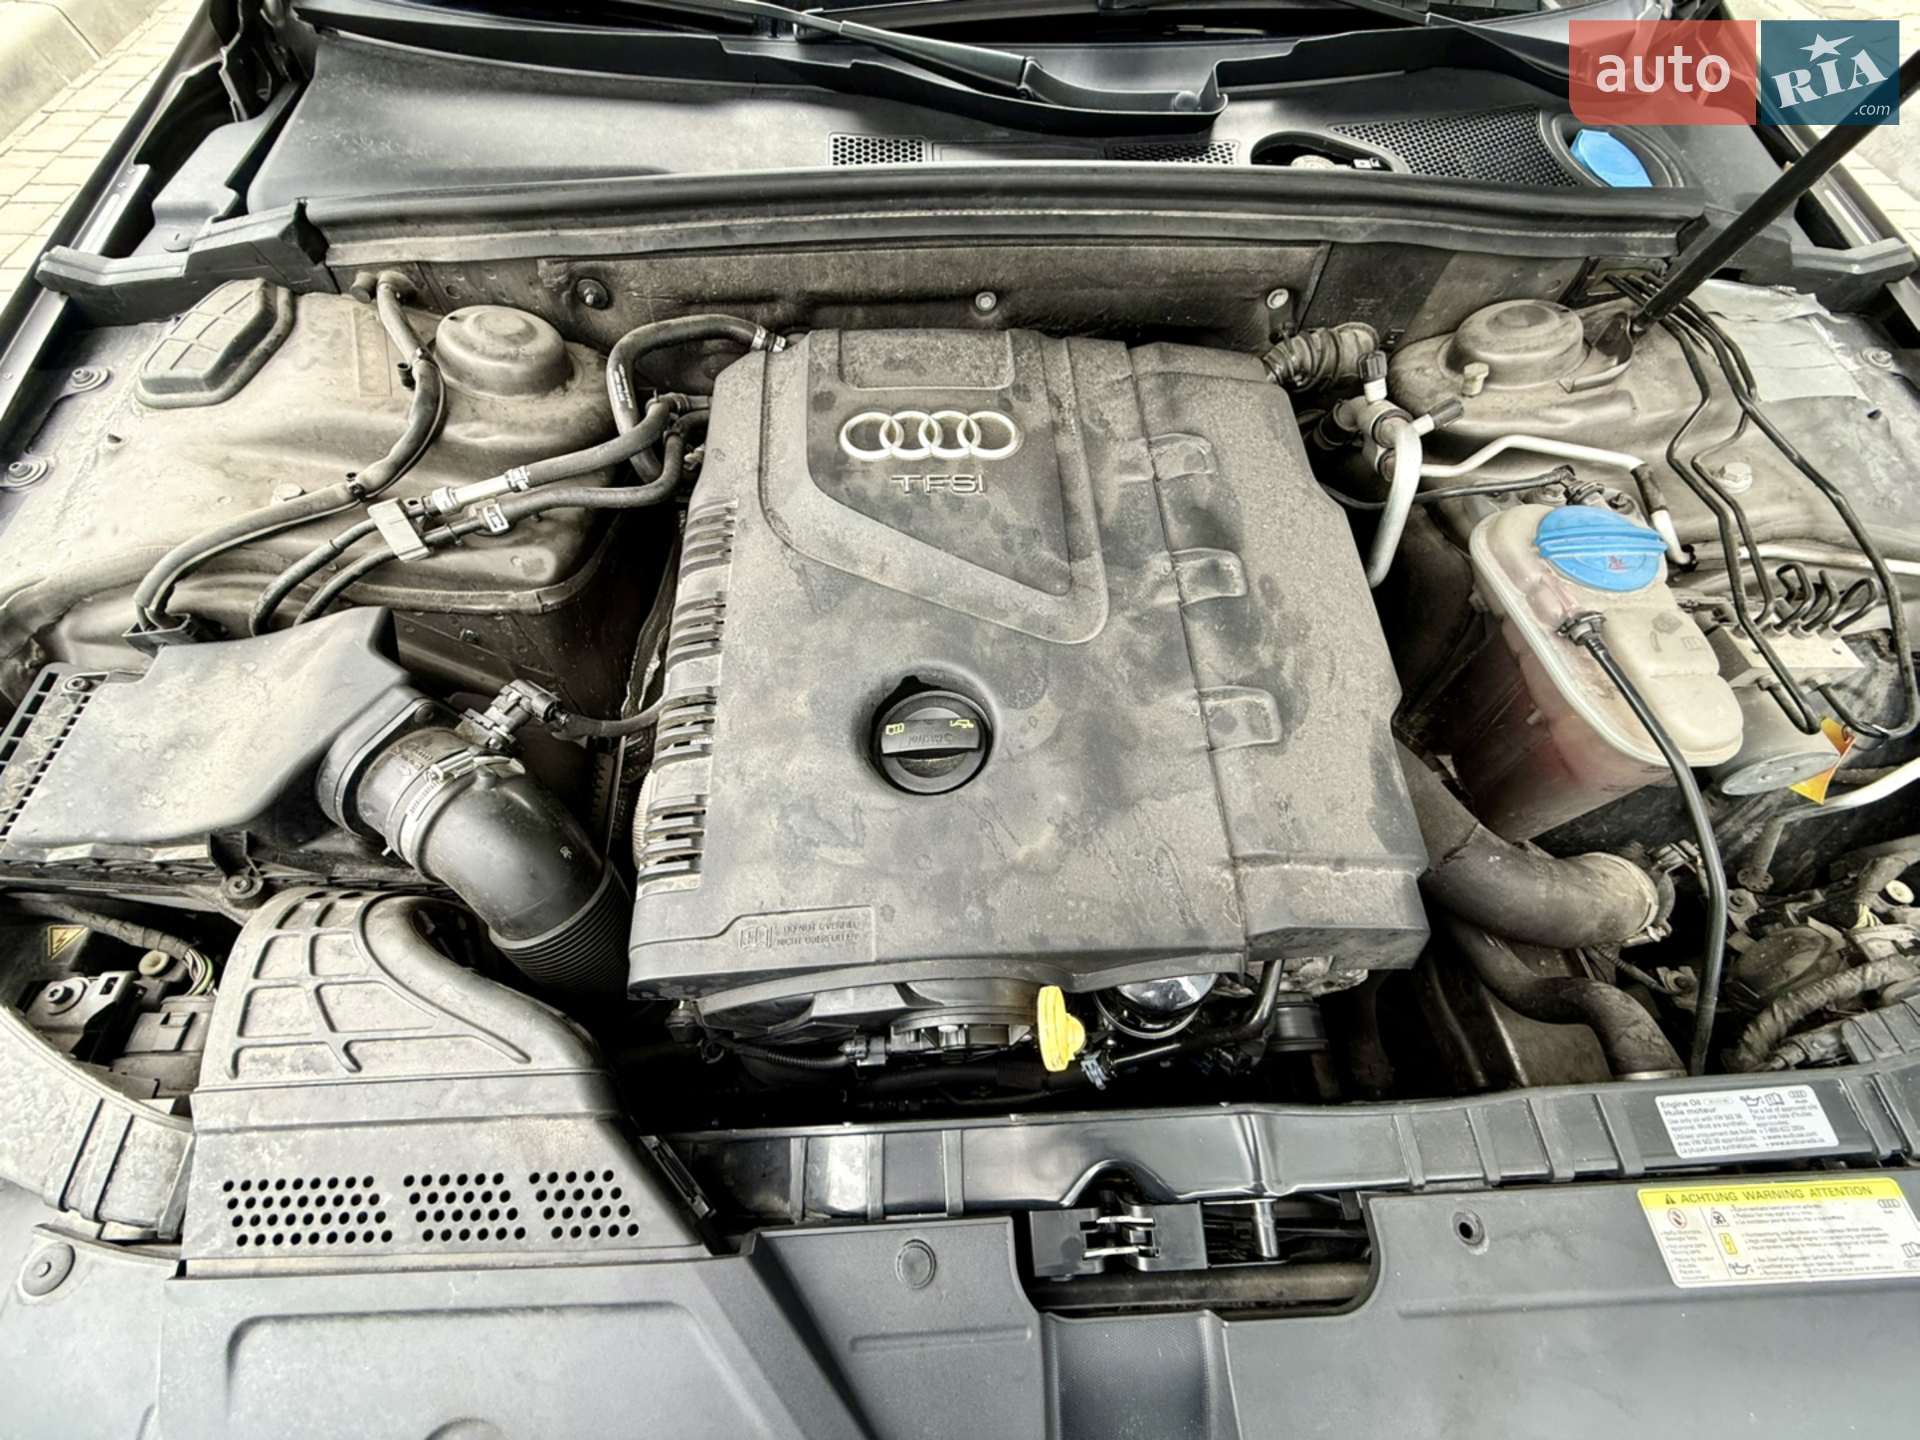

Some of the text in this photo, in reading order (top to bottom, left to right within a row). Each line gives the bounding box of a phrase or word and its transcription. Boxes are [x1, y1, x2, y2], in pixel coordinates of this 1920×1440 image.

[891, 474, 987, 494] TFSI
[783, 925, 797, 933] DO
[800, 923, 816, 932] NOT
[777, 937, 801, 946] NICHT
[1661, 1100, 1689, 1109] Engine
[1681, 1186, 1873, 1204] ACHTUNG WARNING ATTENTION
